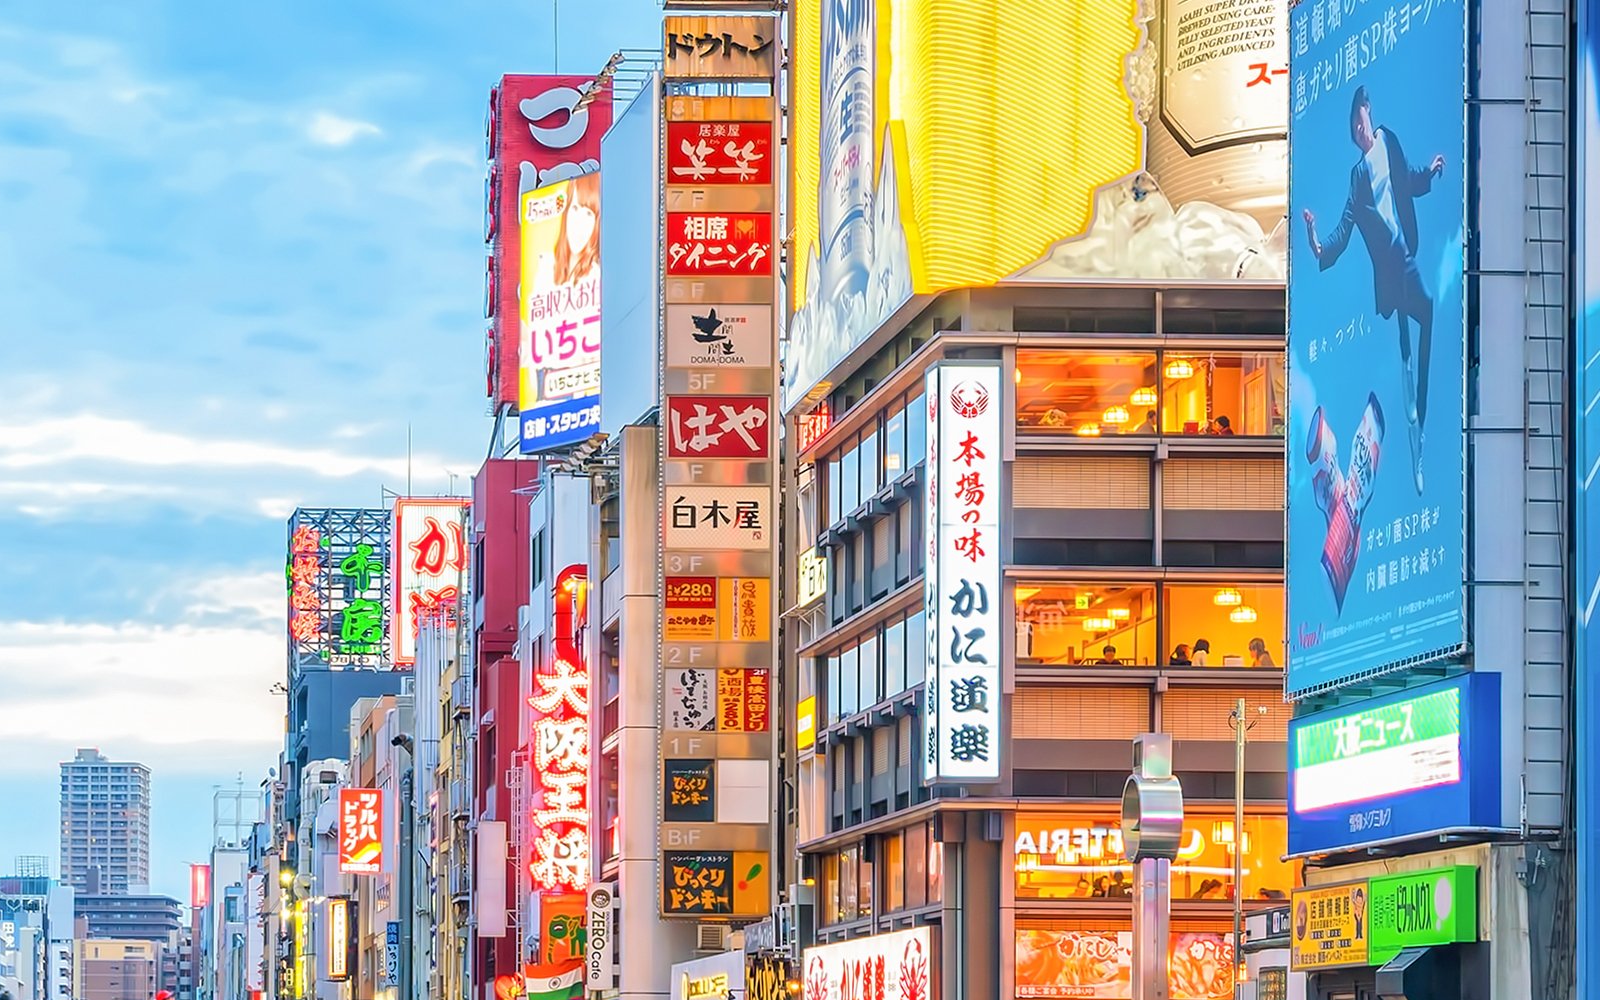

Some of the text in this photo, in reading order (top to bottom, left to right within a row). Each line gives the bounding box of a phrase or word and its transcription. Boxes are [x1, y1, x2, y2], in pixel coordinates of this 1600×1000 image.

[1177, 17, 1212, 37] BREWED
[1212, 9, 1242, 23] USING
[1177, 16, 1276, 48] FULLY SELECTED YEAST
[1177, 28, 1276, 60] AND INGREDIENTS
[1177, 40, 1276, 72] UTILISING ADVANCED
[699, 124, 741, 137] 居楽屋
[684, 216, 729, 240] 相席
[668, 241, 770, 271] ダイニング
[952, 429, 986, 563] 本場の味
[671, 496, 763, 530] 白木屋
[1366, 506, 1441, 552] ガセリ菌SP株が
[1366, 545, 1446, 593] 内臓脂肪を減らす
[948, 578, 990, 763] かに道楽
[528, 659, 590, 890] 大阪王将
[672, 776, 708, 791] びっくり
[670, 791, 709, 805] ドンキー
[670, 855, 729, 863] ハンバーグレストラン
[672, 865, 726, 889] びっくり
[670, 888, 729, 910] ドンキー
[590, 911, 606, 980] ZERO cafe
